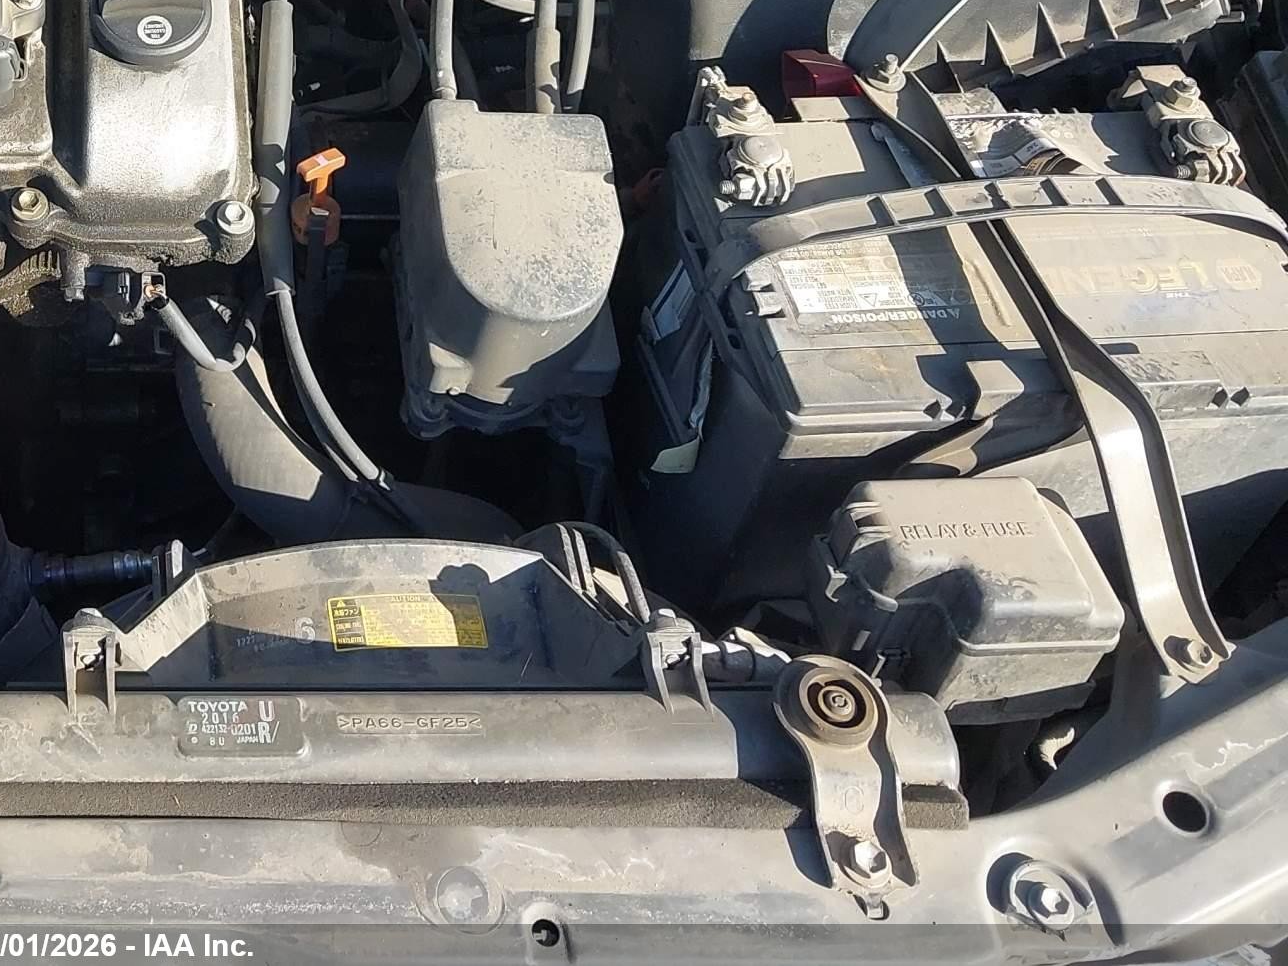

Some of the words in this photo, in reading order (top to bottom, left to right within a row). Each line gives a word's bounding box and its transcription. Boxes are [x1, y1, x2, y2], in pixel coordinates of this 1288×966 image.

[831, 309, 947, 324] DANGER/POISON
[899, 523, 958, 539] RELAY
[962, 523, 976, 536] &
[980, 521, 1034, 537] FUSE
[187, 700, 248, 712] TOYOTA
[258, 700, 275, 722] U
